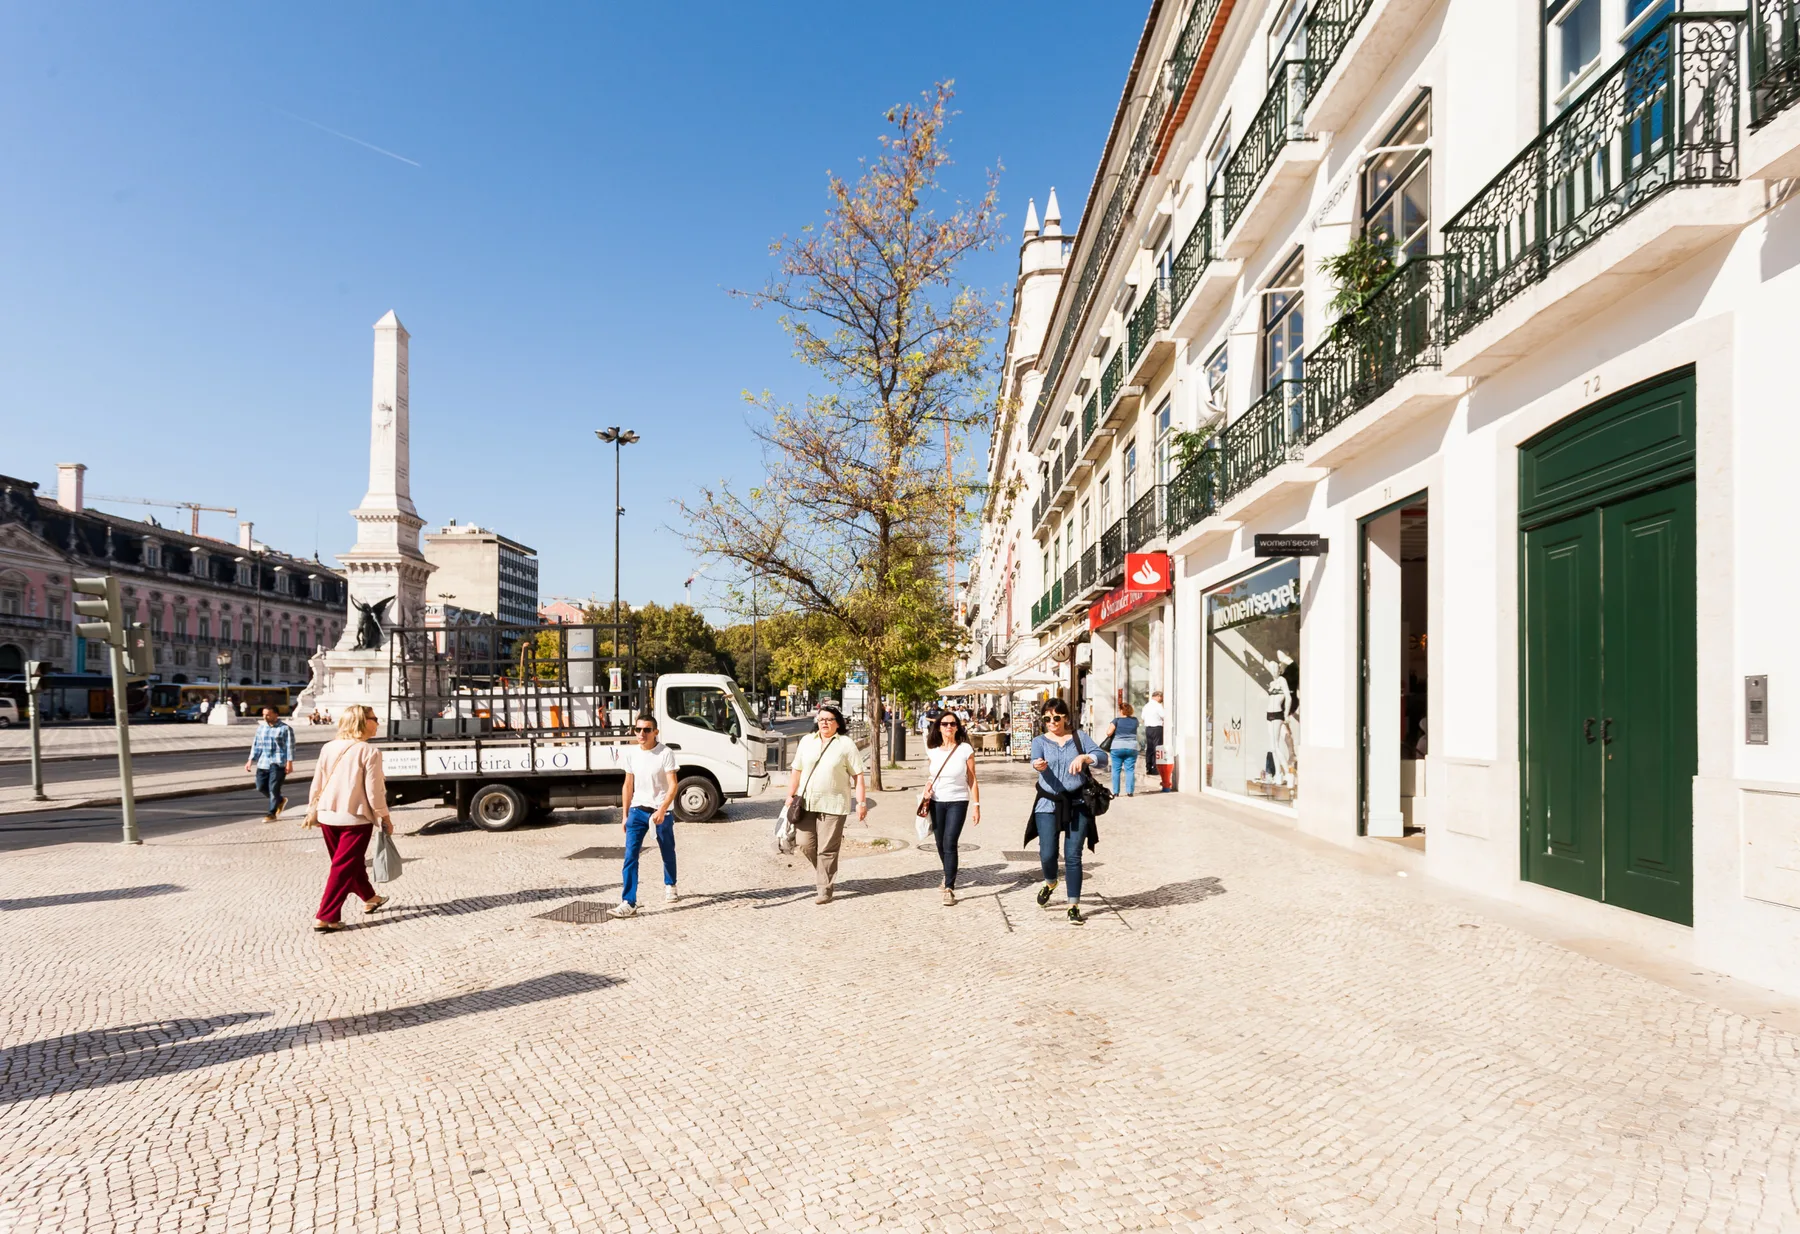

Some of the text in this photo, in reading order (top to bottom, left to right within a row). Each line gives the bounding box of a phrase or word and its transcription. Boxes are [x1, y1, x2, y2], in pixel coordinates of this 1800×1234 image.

[1584, 375, 1600, 397] 72
[1260, 539, 1319, 547] women'secret
[1213, 578, 1297, 630] women'secret
[438, 754, 512, 770] Vidreira
[520, 753, 545, 769] do
